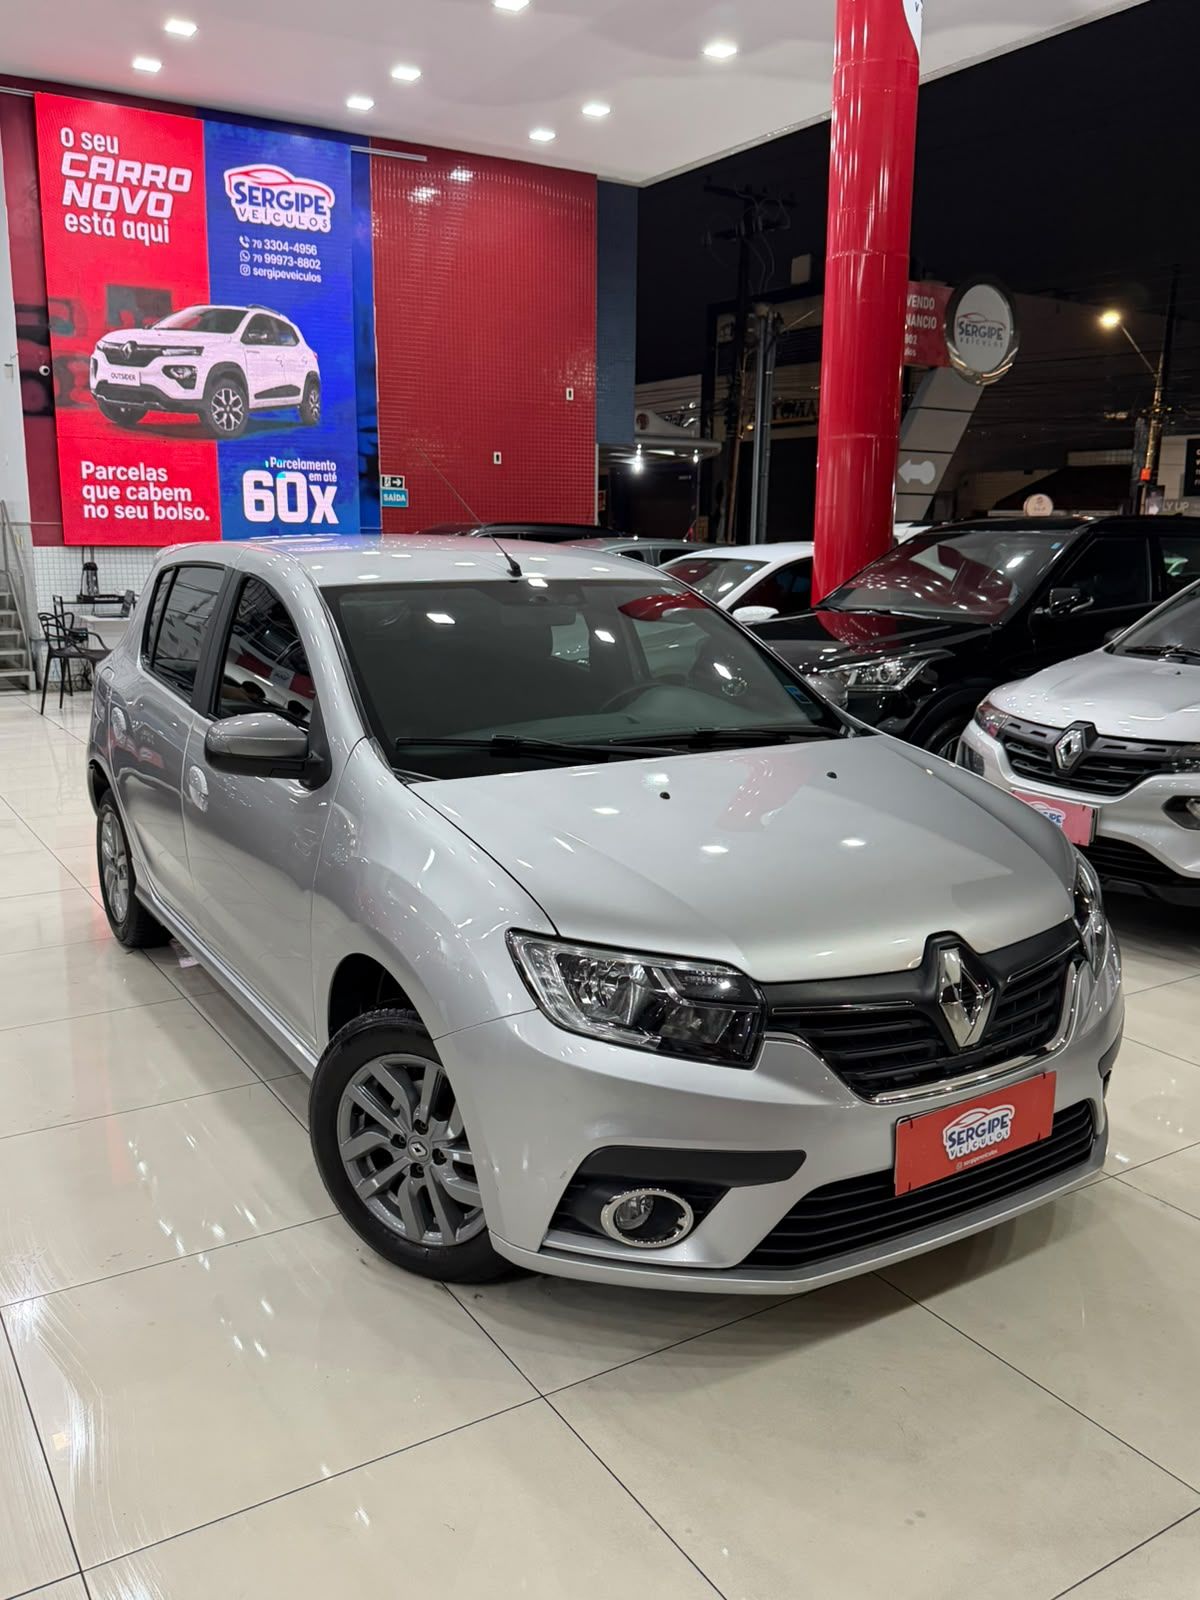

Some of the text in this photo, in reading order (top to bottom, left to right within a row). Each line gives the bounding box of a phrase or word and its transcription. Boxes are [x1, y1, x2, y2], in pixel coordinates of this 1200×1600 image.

[80, 131, 119, 155] seu
[61, 151, 193, 193] CARRO
[62, 179, 174, 219] NOVO
[233, 181, 327, 216] SERGIPE
[64, 211, 170, 247] está aqui
[239, 207, 328, 229] VEÍCULOS
[263, 239, 318, 256] 3304-4956
[264, 253, 321, 270] 99973-8802
[252, 267, 322, 283] sergipeveiculos
[905, 313, 938, 330] NANCIO
[958, 321, 1003, 341] SERGIPE
[80, 460, 169, 482] Parcelas
[270, 456, 337, 471] Parcelamento
[308, 471, 338, 483] em até
[82, 482, 192, 504] que cabem
[242, 469, 340, 525] 60x
[383, 492, 406, 502] SAÍDA
[83, 500, 210, 521] no seu bolso.
[947, 1113, 1009, 1149] SERGIPE
